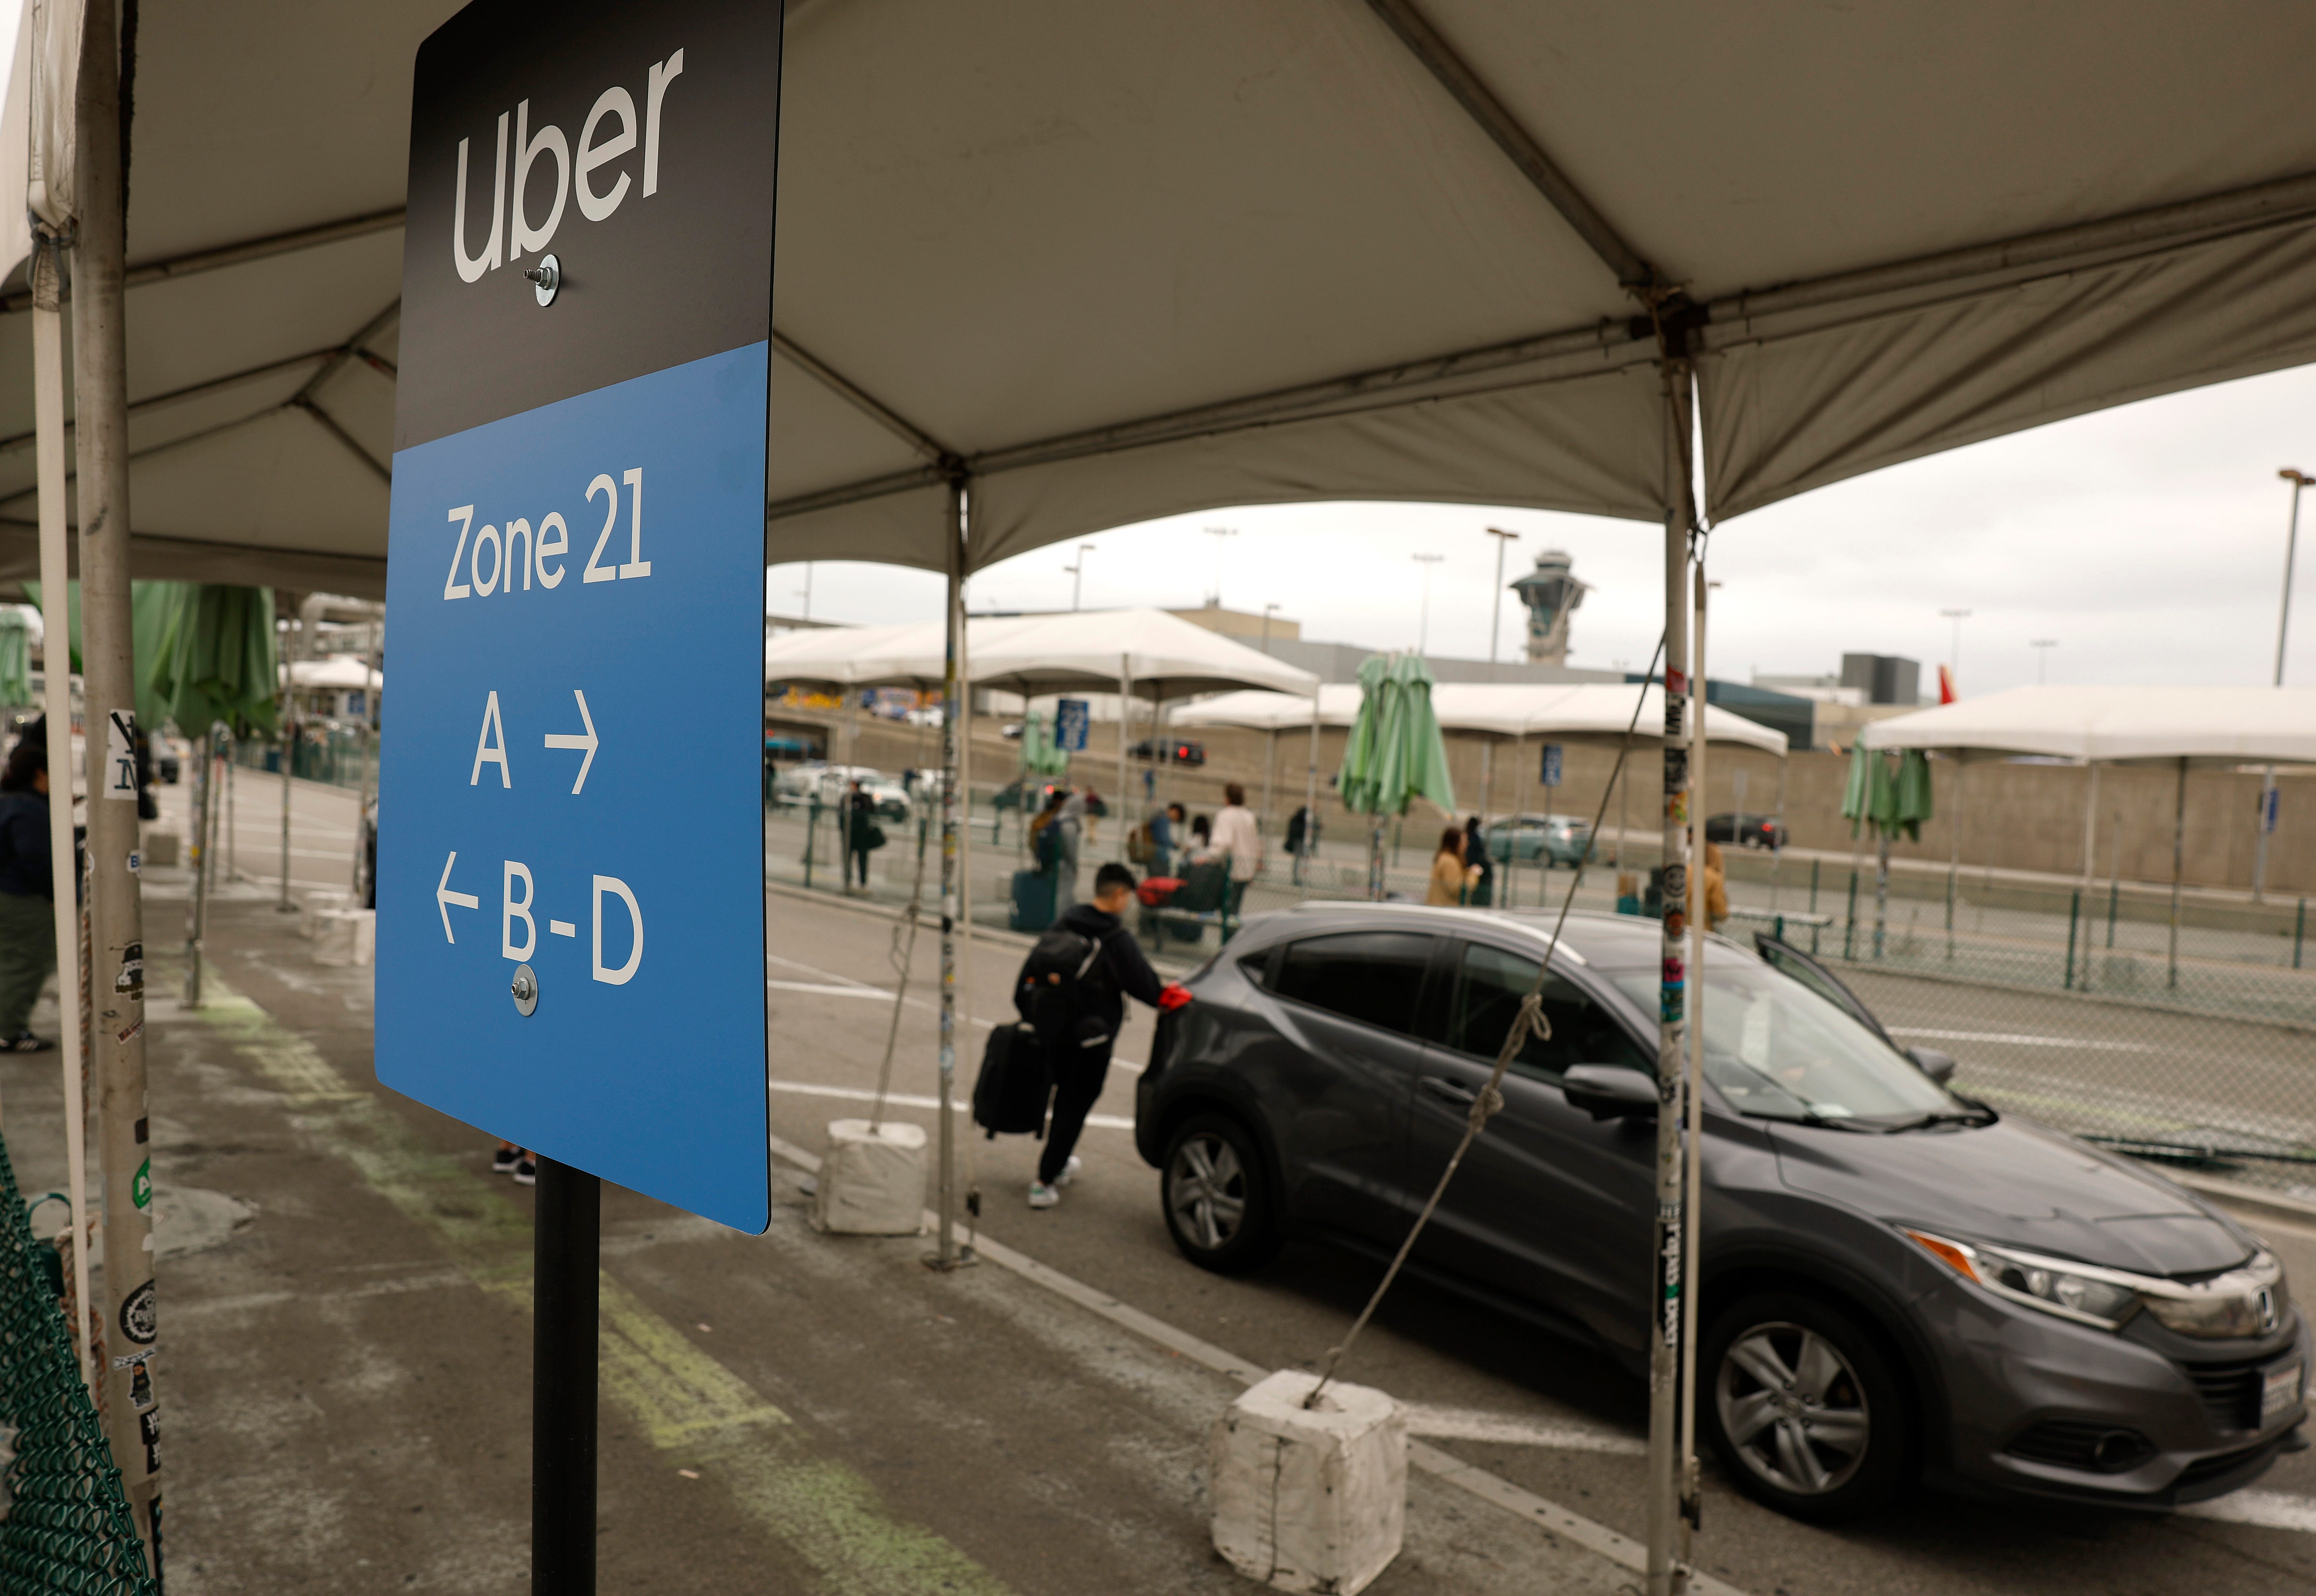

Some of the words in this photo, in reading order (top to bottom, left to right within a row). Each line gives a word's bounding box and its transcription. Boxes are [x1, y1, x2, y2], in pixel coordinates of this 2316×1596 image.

[453, 47, 684, 283] Uber
[443, 504, 569, 601] Zone
[582, 467, 652, 584] 21
[470, 690, 511, 789] A
